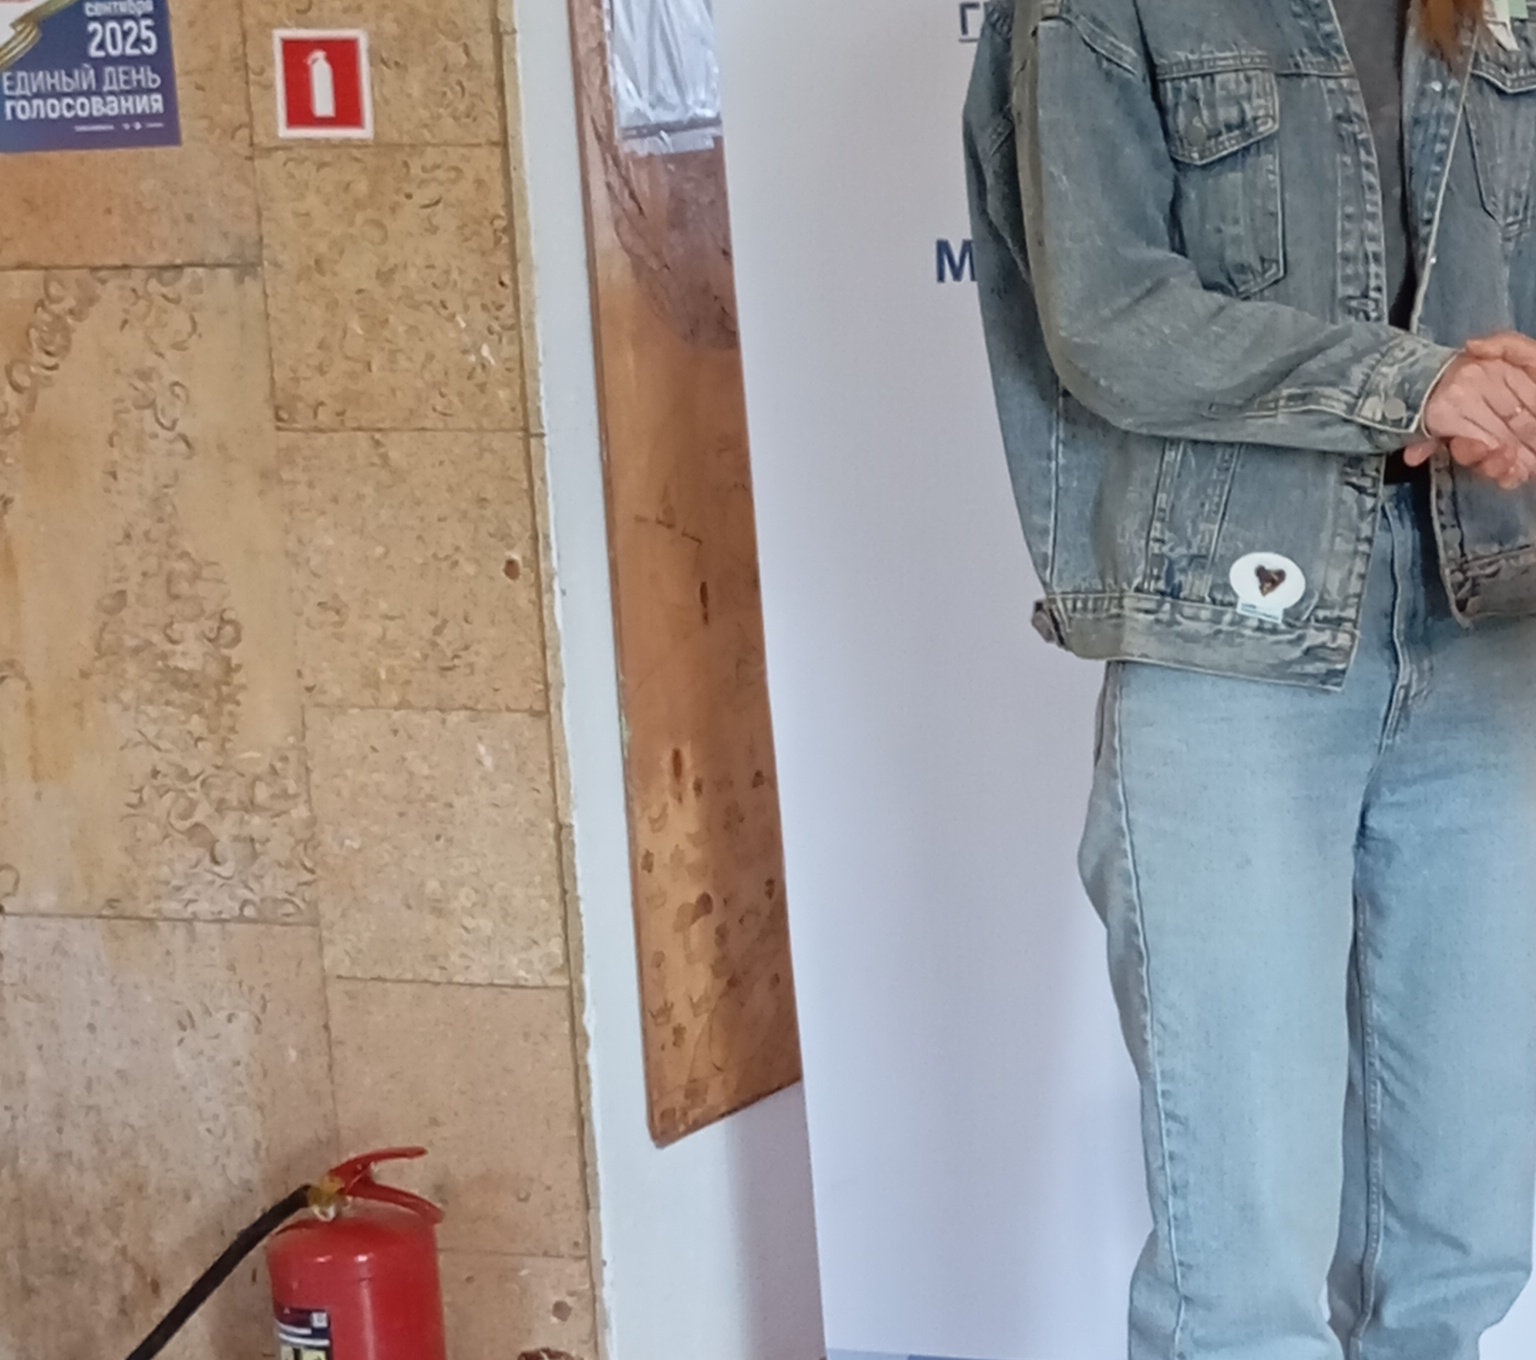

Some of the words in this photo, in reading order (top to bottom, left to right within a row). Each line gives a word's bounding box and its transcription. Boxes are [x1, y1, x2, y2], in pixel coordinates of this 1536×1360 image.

[87, 18, 157, 58] 2025
[2, 63, 97, 96] ЕДИНЫЙ
[103, 65, 161, 92] ДЕНЬ
